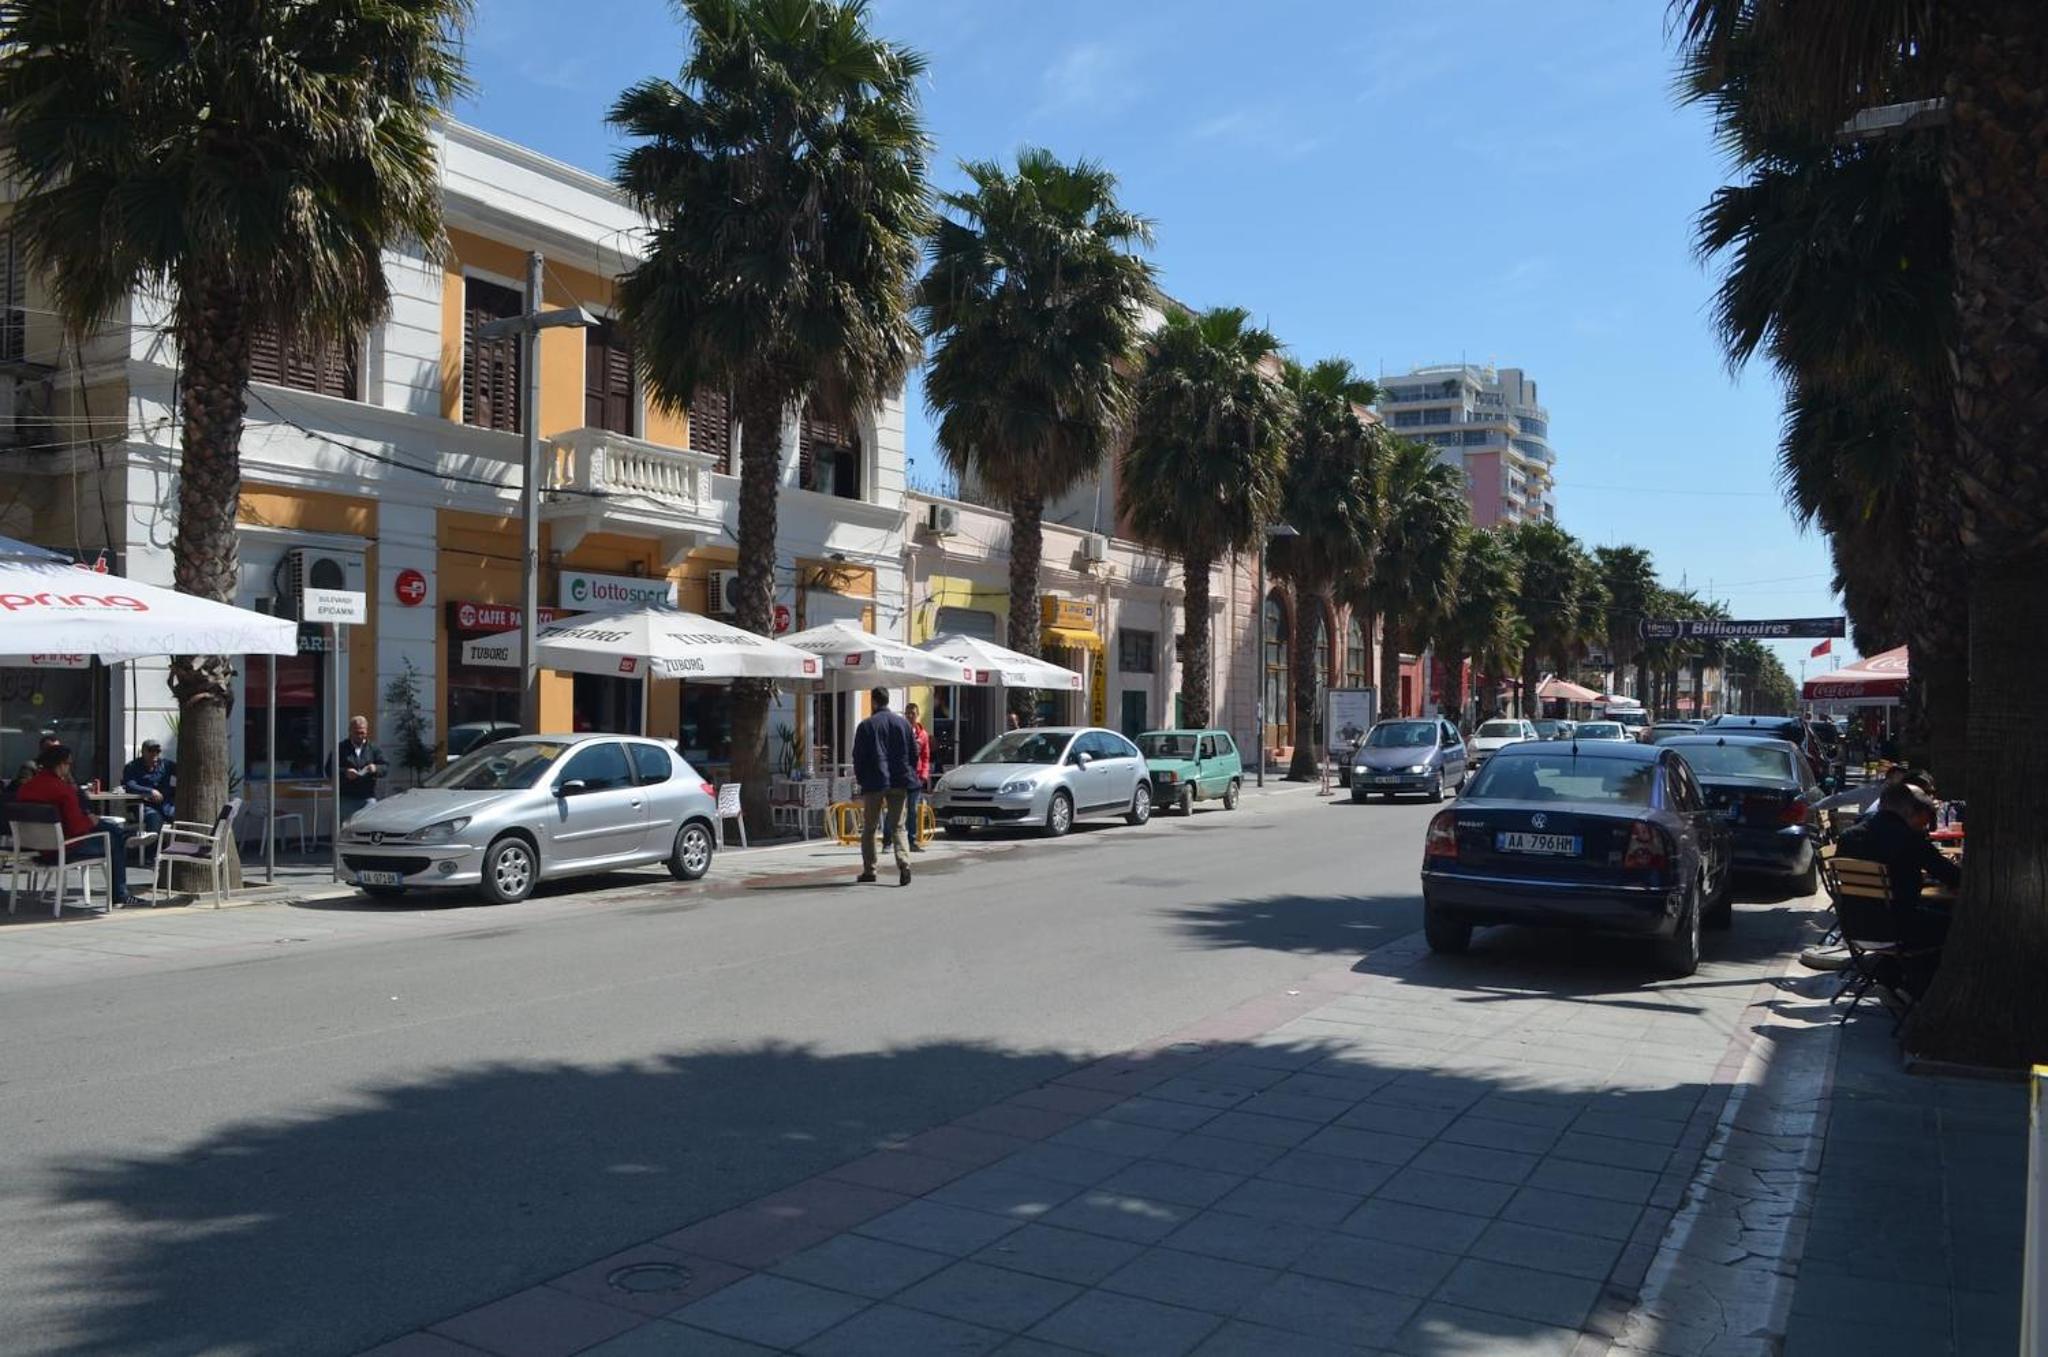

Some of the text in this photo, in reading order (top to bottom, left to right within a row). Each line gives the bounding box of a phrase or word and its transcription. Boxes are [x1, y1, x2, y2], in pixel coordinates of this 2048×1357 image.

[479, 609, 506, 625] CAFFE
[1691, 621, 1791, 635] Billionaires
[471, 647, 509, 661] TUBORG
[663, 657, 704, 673] TUBORG
[1508, 834, 1524, 847] AA
